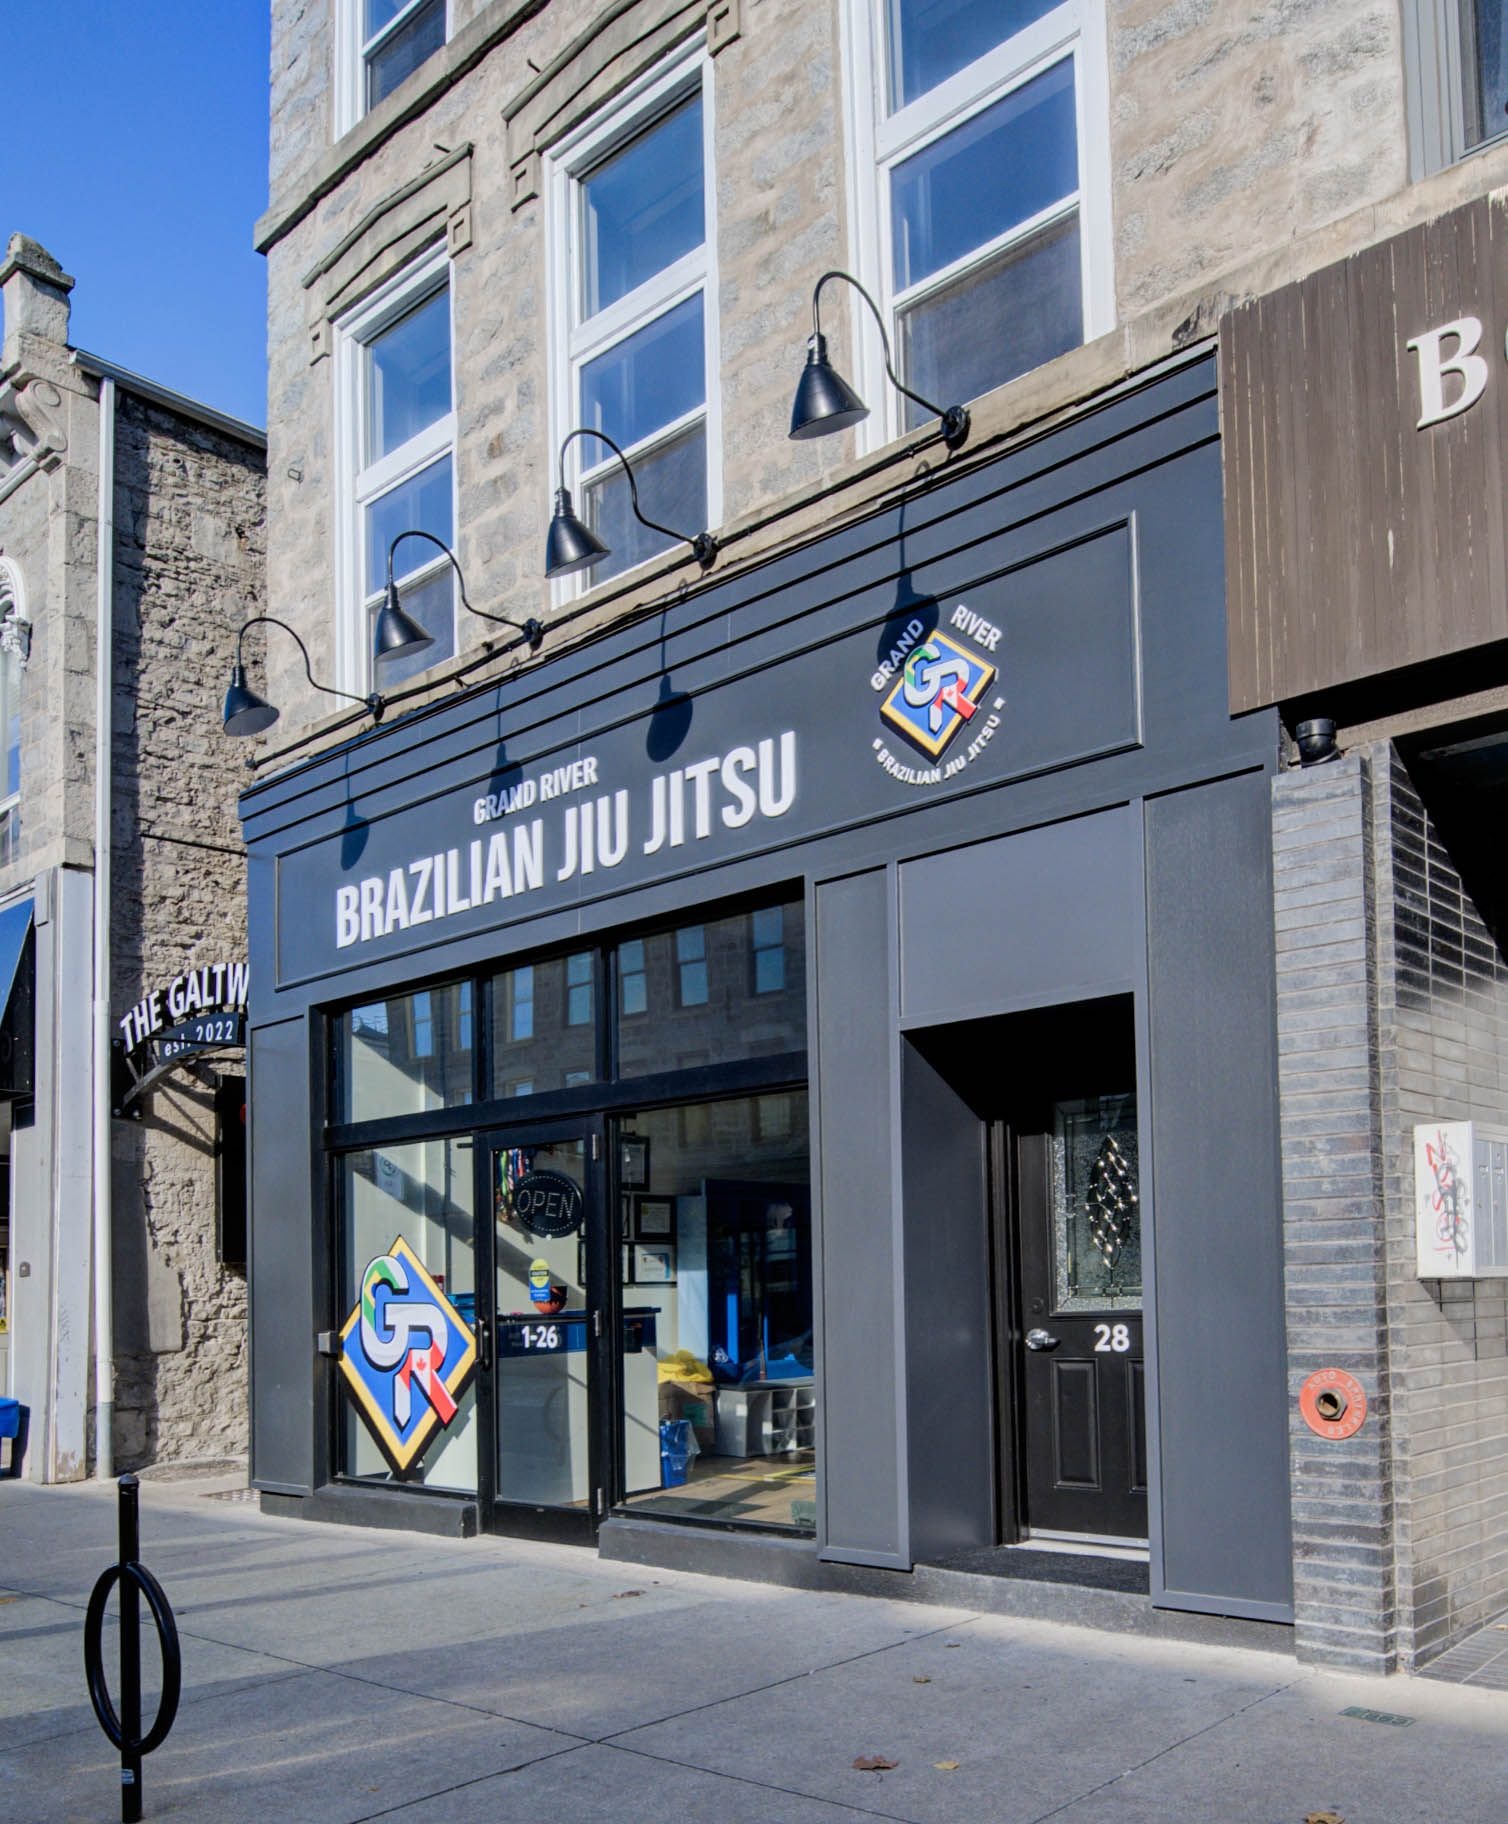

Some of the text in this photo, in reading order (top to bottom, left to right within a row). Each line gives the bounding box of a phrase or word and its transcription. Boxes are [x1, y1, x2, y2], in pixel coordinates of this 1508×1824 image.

[1406, 316, 1508, 432] B
[870, 604, 1003, 692] GRAND RIVER
[876, 714, 1001, 785] BRAZILIAN JIU JITSU
[473, 756, 599, 825] GRAND RIVER
[336, 730, 797, 949] BRAZILIAN JIU JITSU
[120, 990, 162, 1053] THE
[196, 1020, 234, 1043] 2022
[517, 1189, 575, 1219] OPEN
[360, 1254, 458, 1432] GR
[521, 1325, 558, 1349] 1-26
[1094, 1323, 1130, 1353] 28
